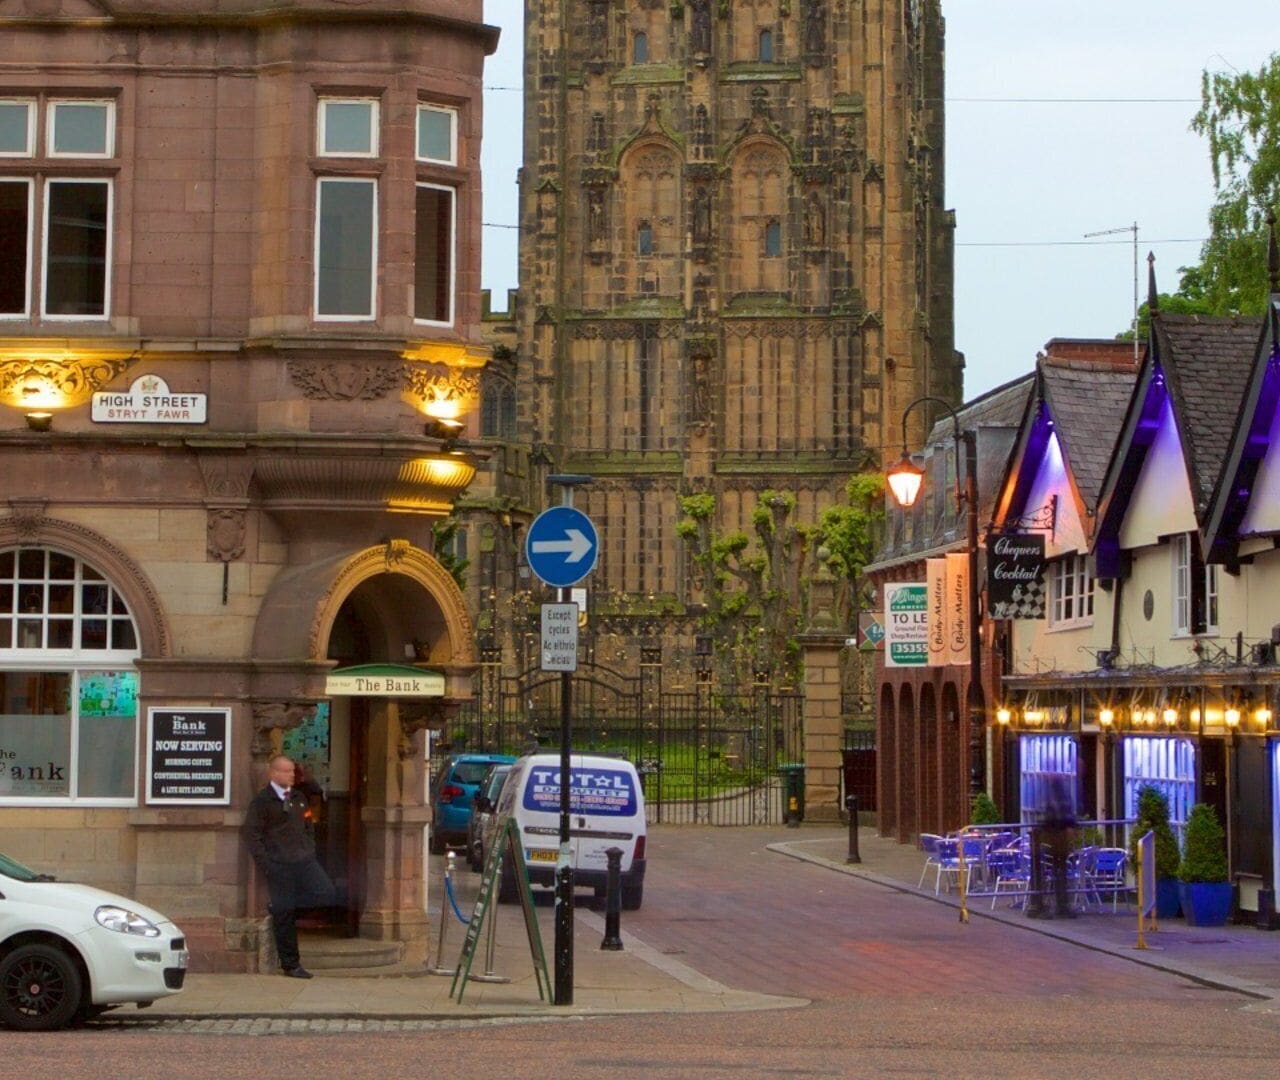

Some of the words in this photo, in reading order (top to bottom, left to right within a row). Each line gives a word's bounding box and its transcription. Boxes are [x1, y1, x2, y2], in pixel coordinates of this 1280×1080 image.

[100, 396, 133, 407] HIGH
[143, 396, 198, 408] STREET
[108, 409, 147, 418] STRYT
[157, 410, 190, 419] FAWR
[994, 536, 1040, 561] Chequers
[994, 561, 1040, 580] Cocktail
[547, 610, 572, 623] Except
[892, 613, 908, 624] TO
[913, 613, 927, 624] LE
[548, 625, 570, 636] cycles
[355, 679, 381, 692] The
[385, 679, 421, 692] Bank
[172, 721, 206, 730] Bank
[155, 741, 179, 751] NOW
[180, 741, 223, 751] SERVING
